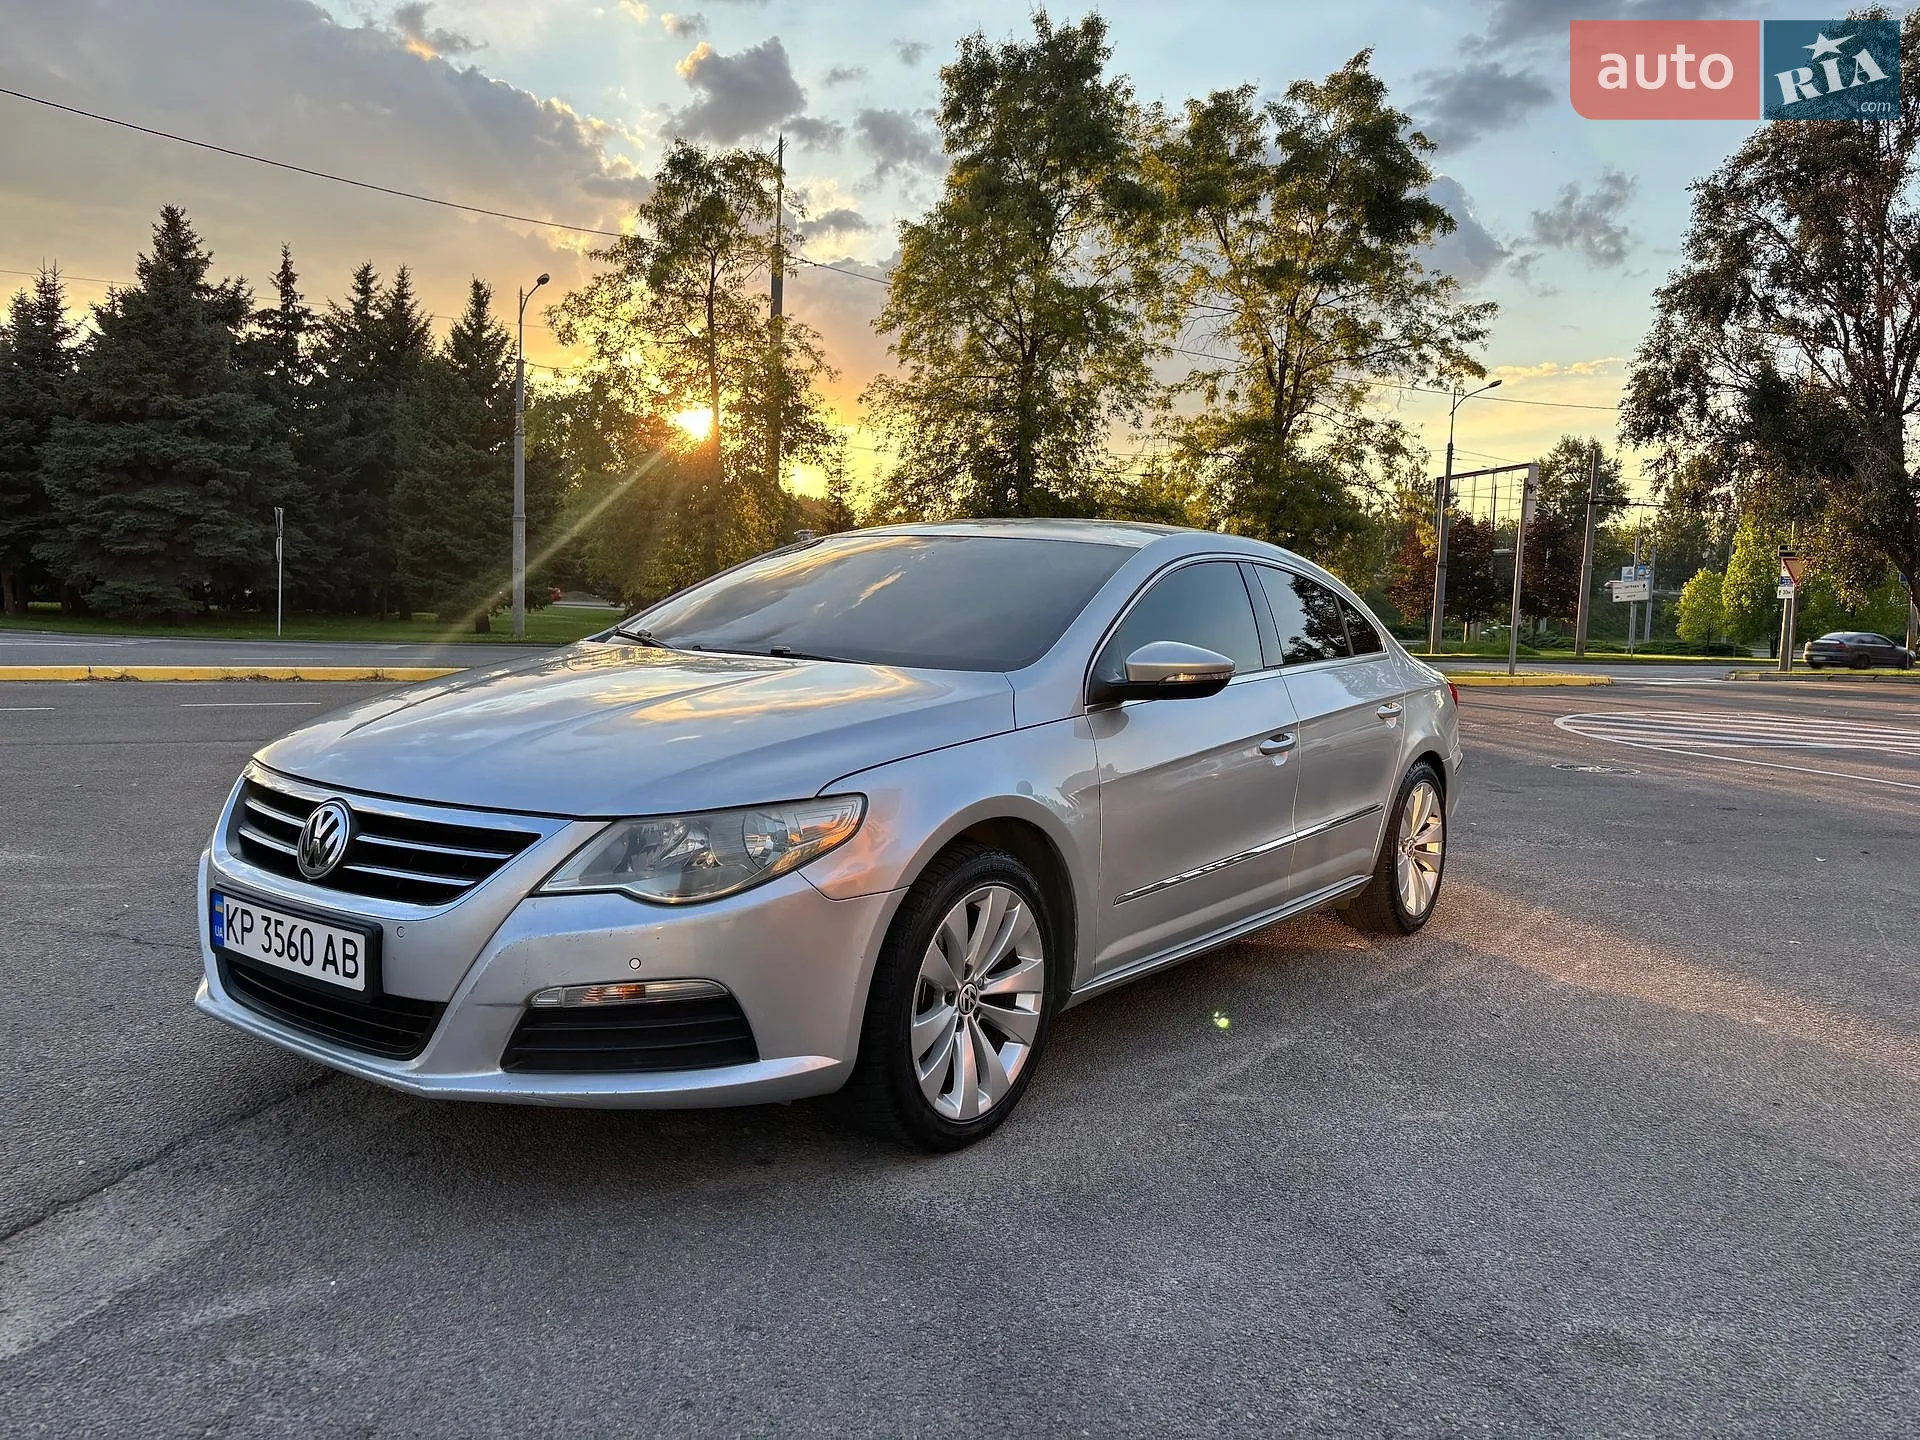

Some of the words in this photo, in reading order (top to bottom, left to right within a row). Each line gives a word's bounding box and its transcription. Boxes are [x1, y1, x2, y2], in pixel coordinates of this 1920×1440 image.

[214, 925, 224, 939] UA
[226, 903, 254, 945] KP
[261, 915, 314, 967] 3560
[321, 934, 359, 979] AB
